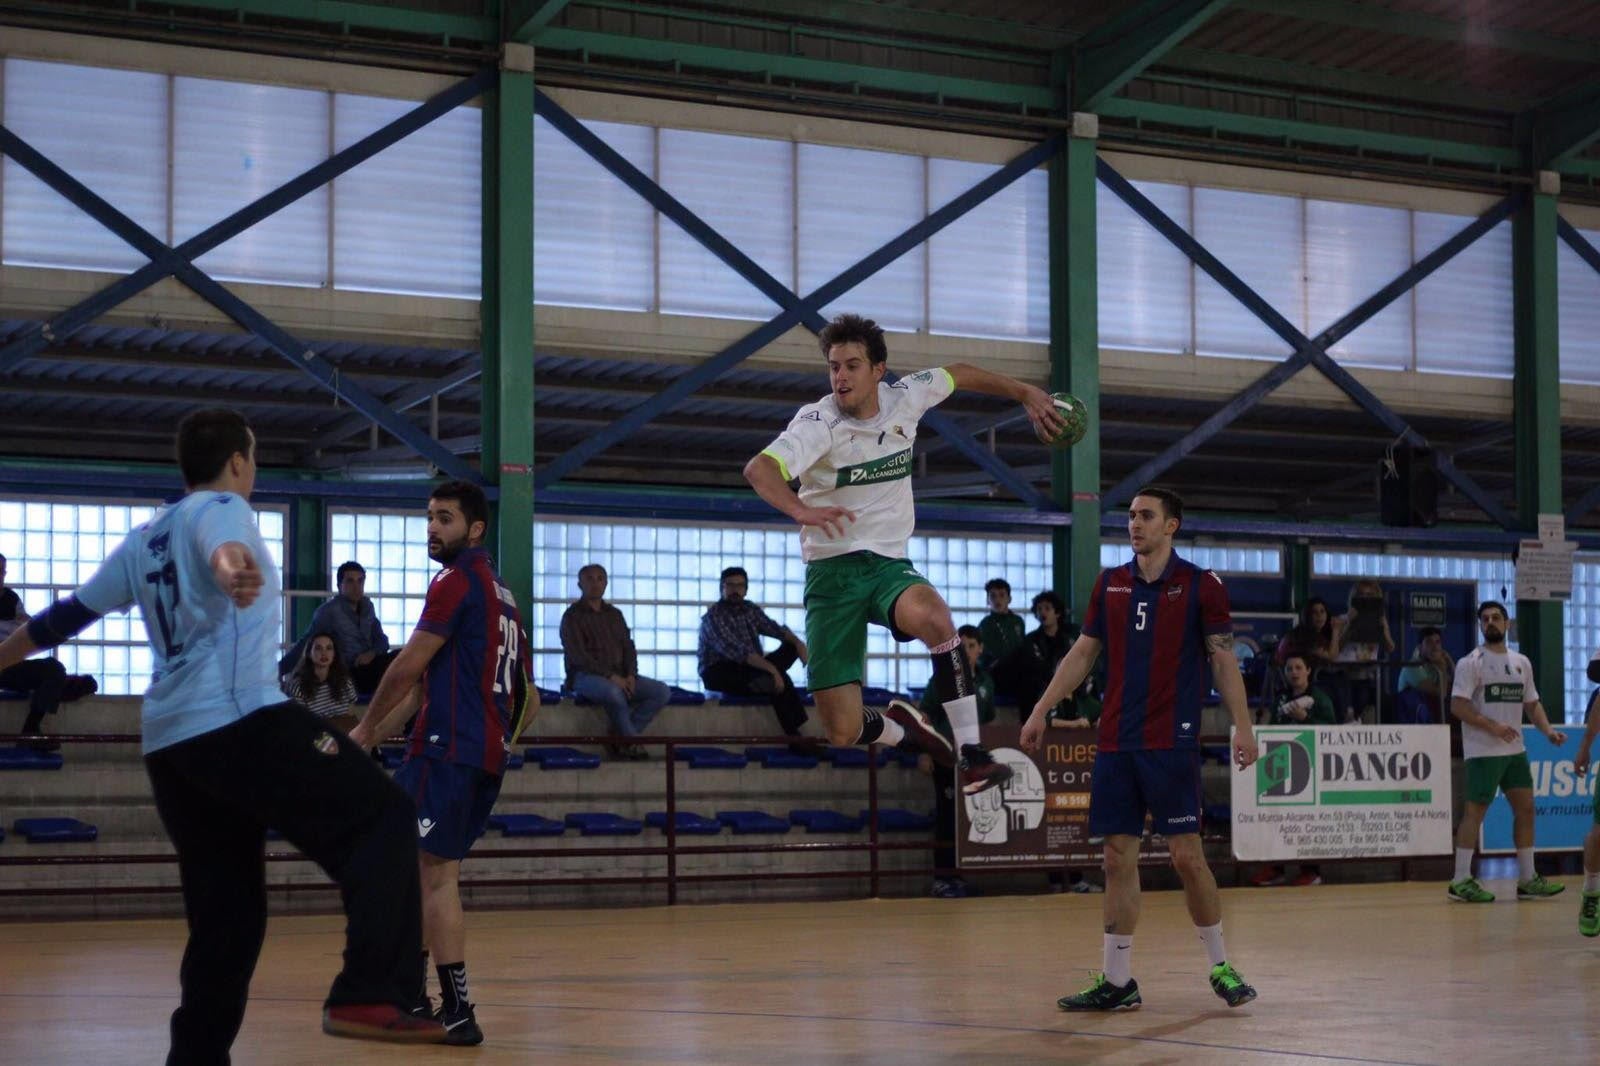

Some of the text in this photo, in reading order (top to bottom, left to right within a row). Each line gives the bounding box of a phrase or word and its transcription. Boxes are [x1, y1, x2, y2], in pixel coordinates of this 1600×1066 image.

[1413, 597, 1443, 608] SALIDA
[1135, 602, 1148, 631] 5
[1320, 731, 1402, 746] PLANTILLAS
[1321, 751, 1432, 781] DANGO
